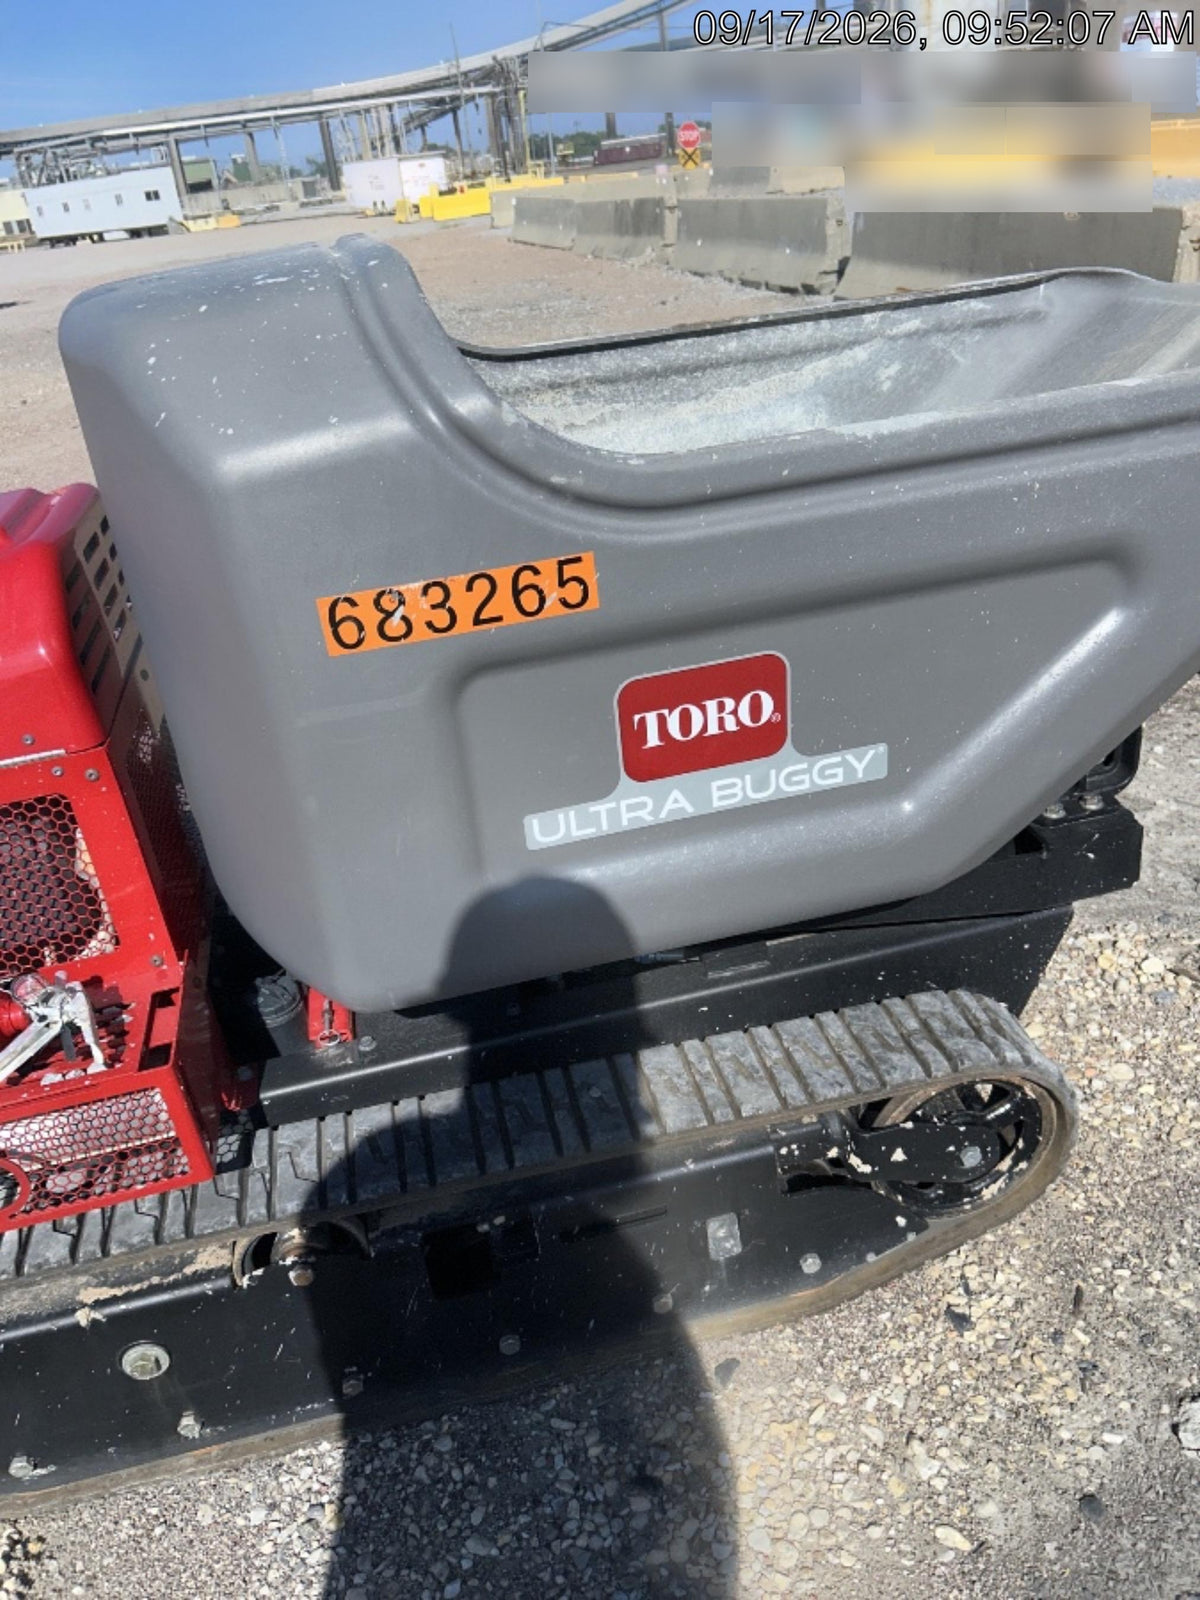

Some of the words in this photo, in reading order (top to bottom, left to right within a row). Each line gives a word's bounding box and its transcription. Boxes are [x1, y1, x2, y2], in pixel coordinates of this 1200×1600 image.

[679, 130, 699, 141] STOP
[327, 556, 589, 650] 683265
[633, 689, 775, 749] TORO
[532, 788, 694, 844] ULTRA
[710, 749, 876, 808] BUGGY
